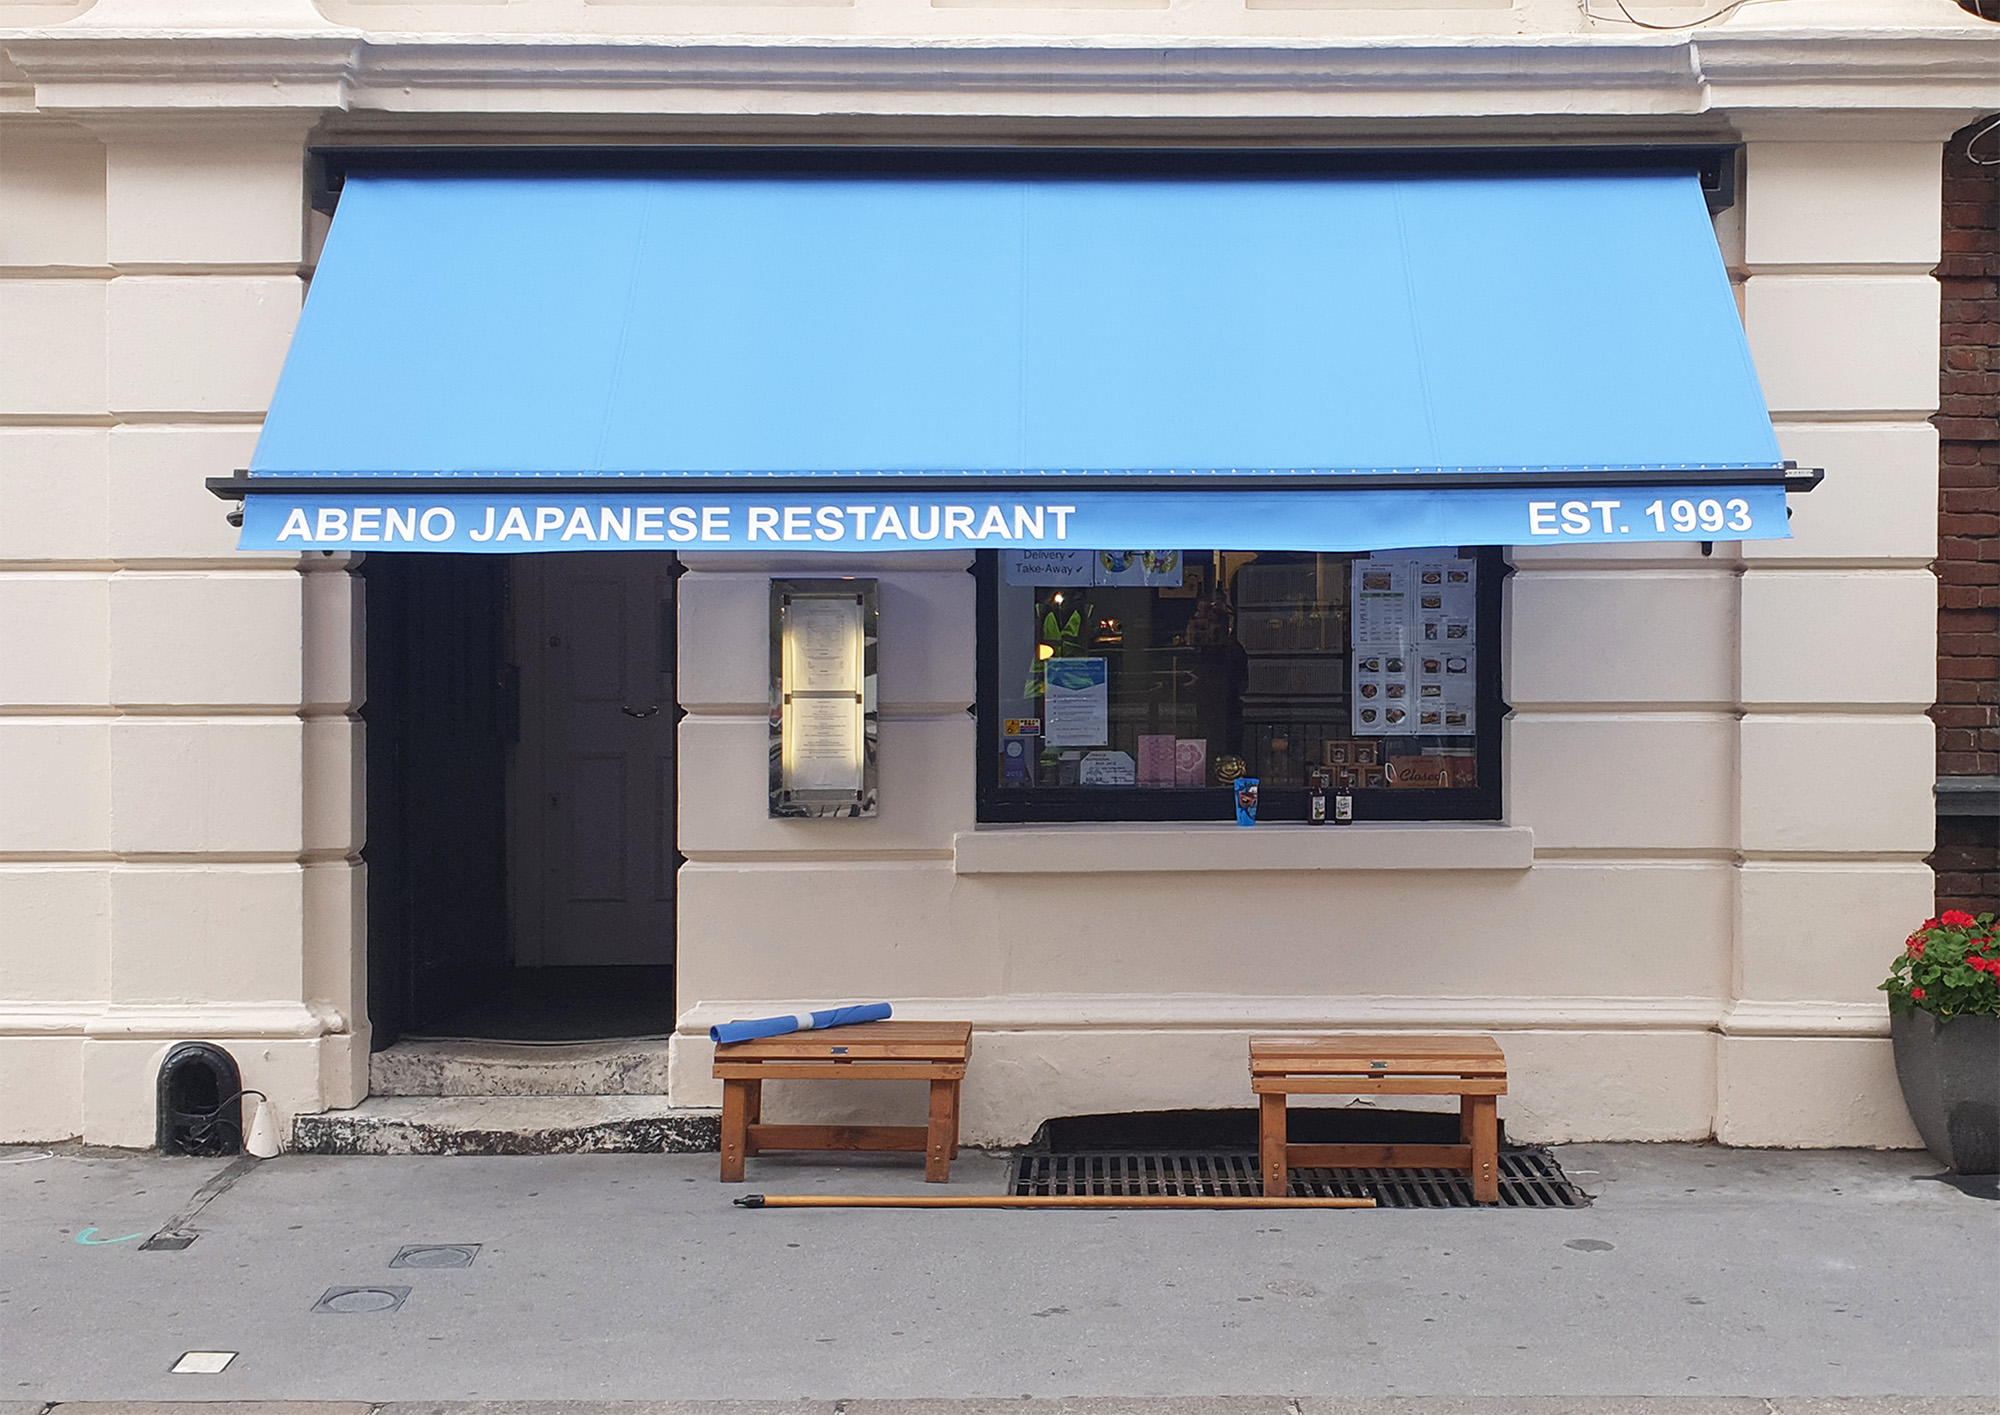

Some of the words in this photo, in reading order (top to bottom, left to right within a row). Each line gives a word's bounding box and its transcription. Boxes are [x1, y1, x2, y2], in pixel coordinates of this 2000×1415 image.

[276, 507, 456, 542] ABENO
[469, 506, 731, 542] JAPANESE
[747, 505, 1076, 542] RESTAURANT
[1528, 500, 1630, 536] EST.
[1645, 498, 1753, 533] 1993
[1024, 550, 1065, 561] Delivery
[1016, 563, 1073, 576] Take-Away
